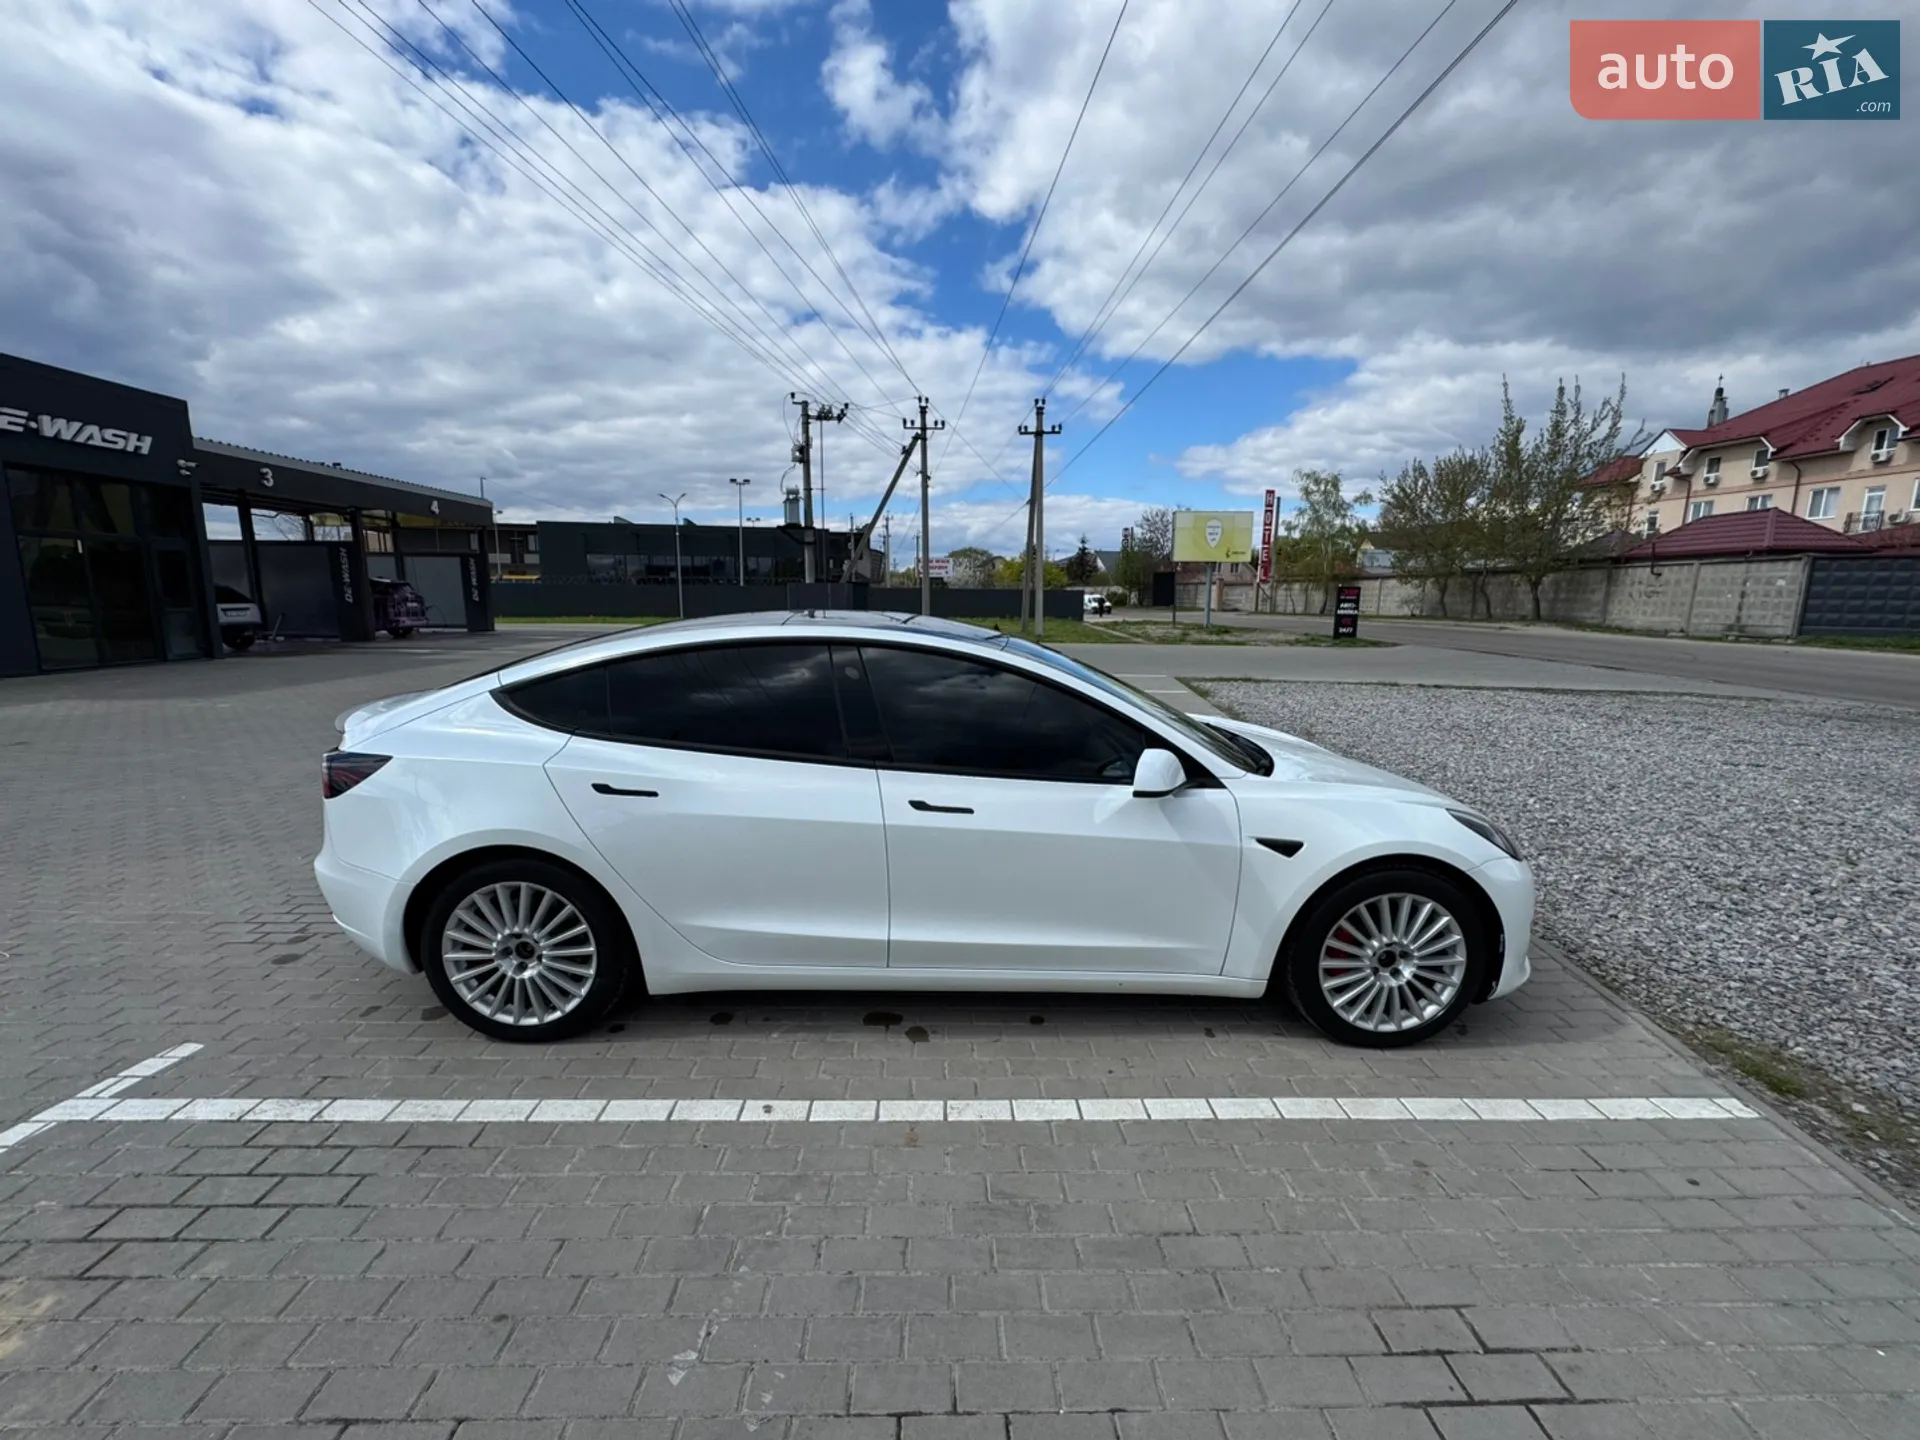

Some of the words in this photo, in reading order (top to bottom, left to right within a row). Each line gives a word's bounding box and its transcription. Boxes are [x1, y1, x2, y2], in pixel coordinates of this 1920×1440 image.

[260, 467, 274, 487] 3
[430, 500, 440, 515] 4
[1261, 491, 1274, 580] HOTEL
